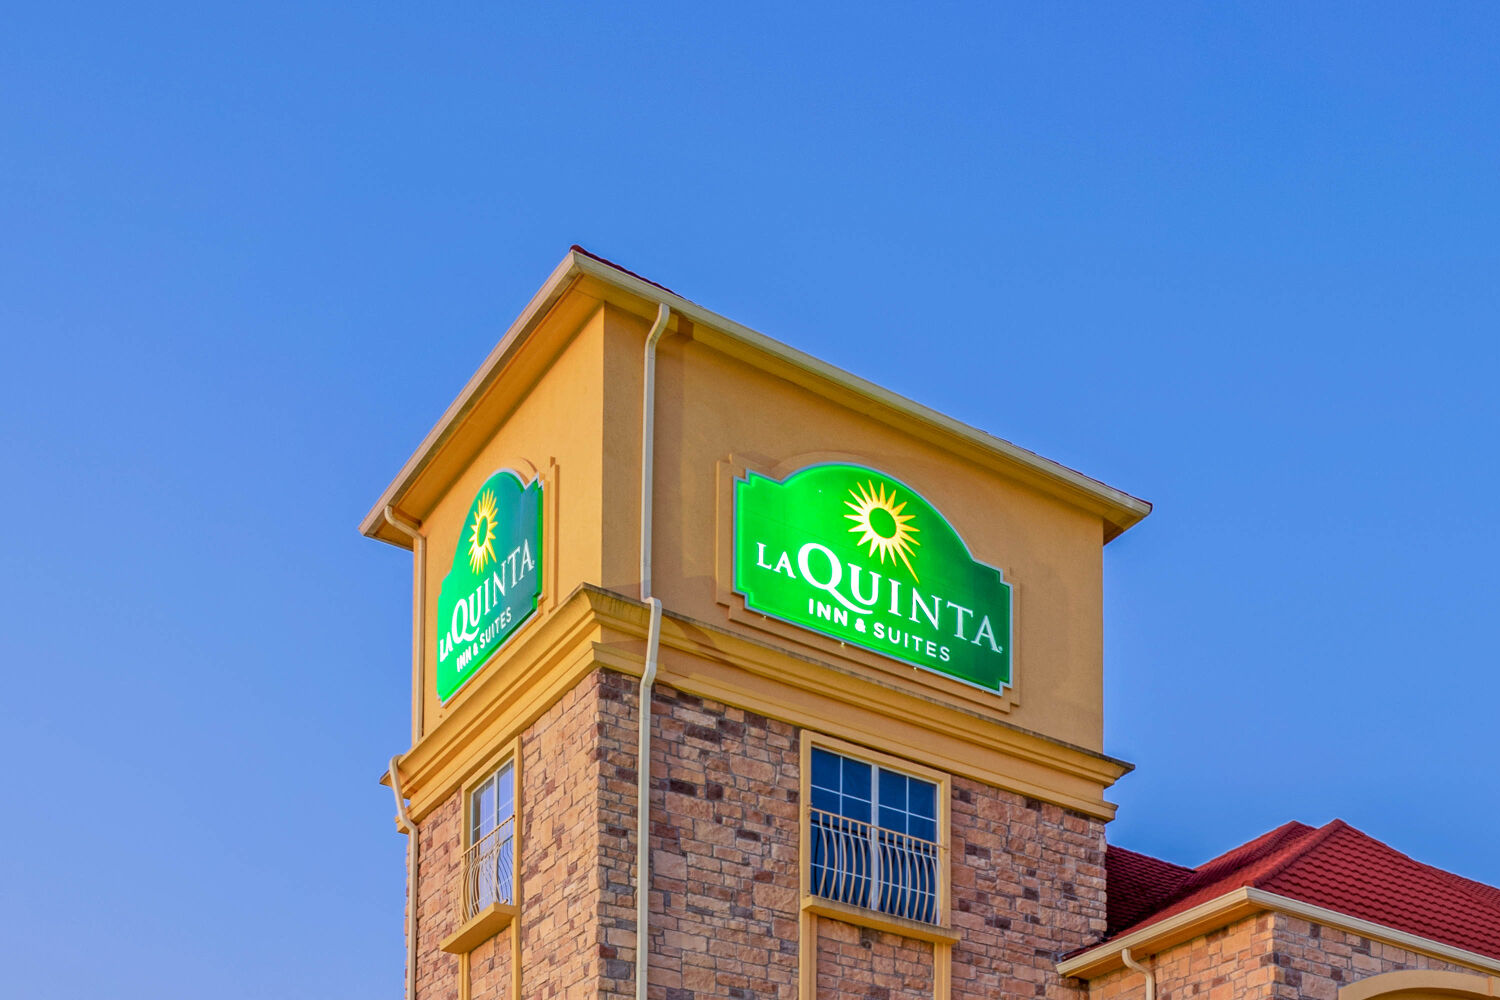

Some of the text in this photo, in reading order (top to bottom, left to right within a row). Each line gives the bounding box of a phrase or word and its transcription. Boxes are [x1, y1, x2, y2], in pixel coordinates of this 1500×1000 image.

[439, 538, 534, 663] LA QUINTA
[456, 645, 473, 673] INN
[480, 606, 512, 649] SUITES
[756, 542, 1002, 654] LA QUINTA
[808, 598, 950, 662] INN & SUITES
